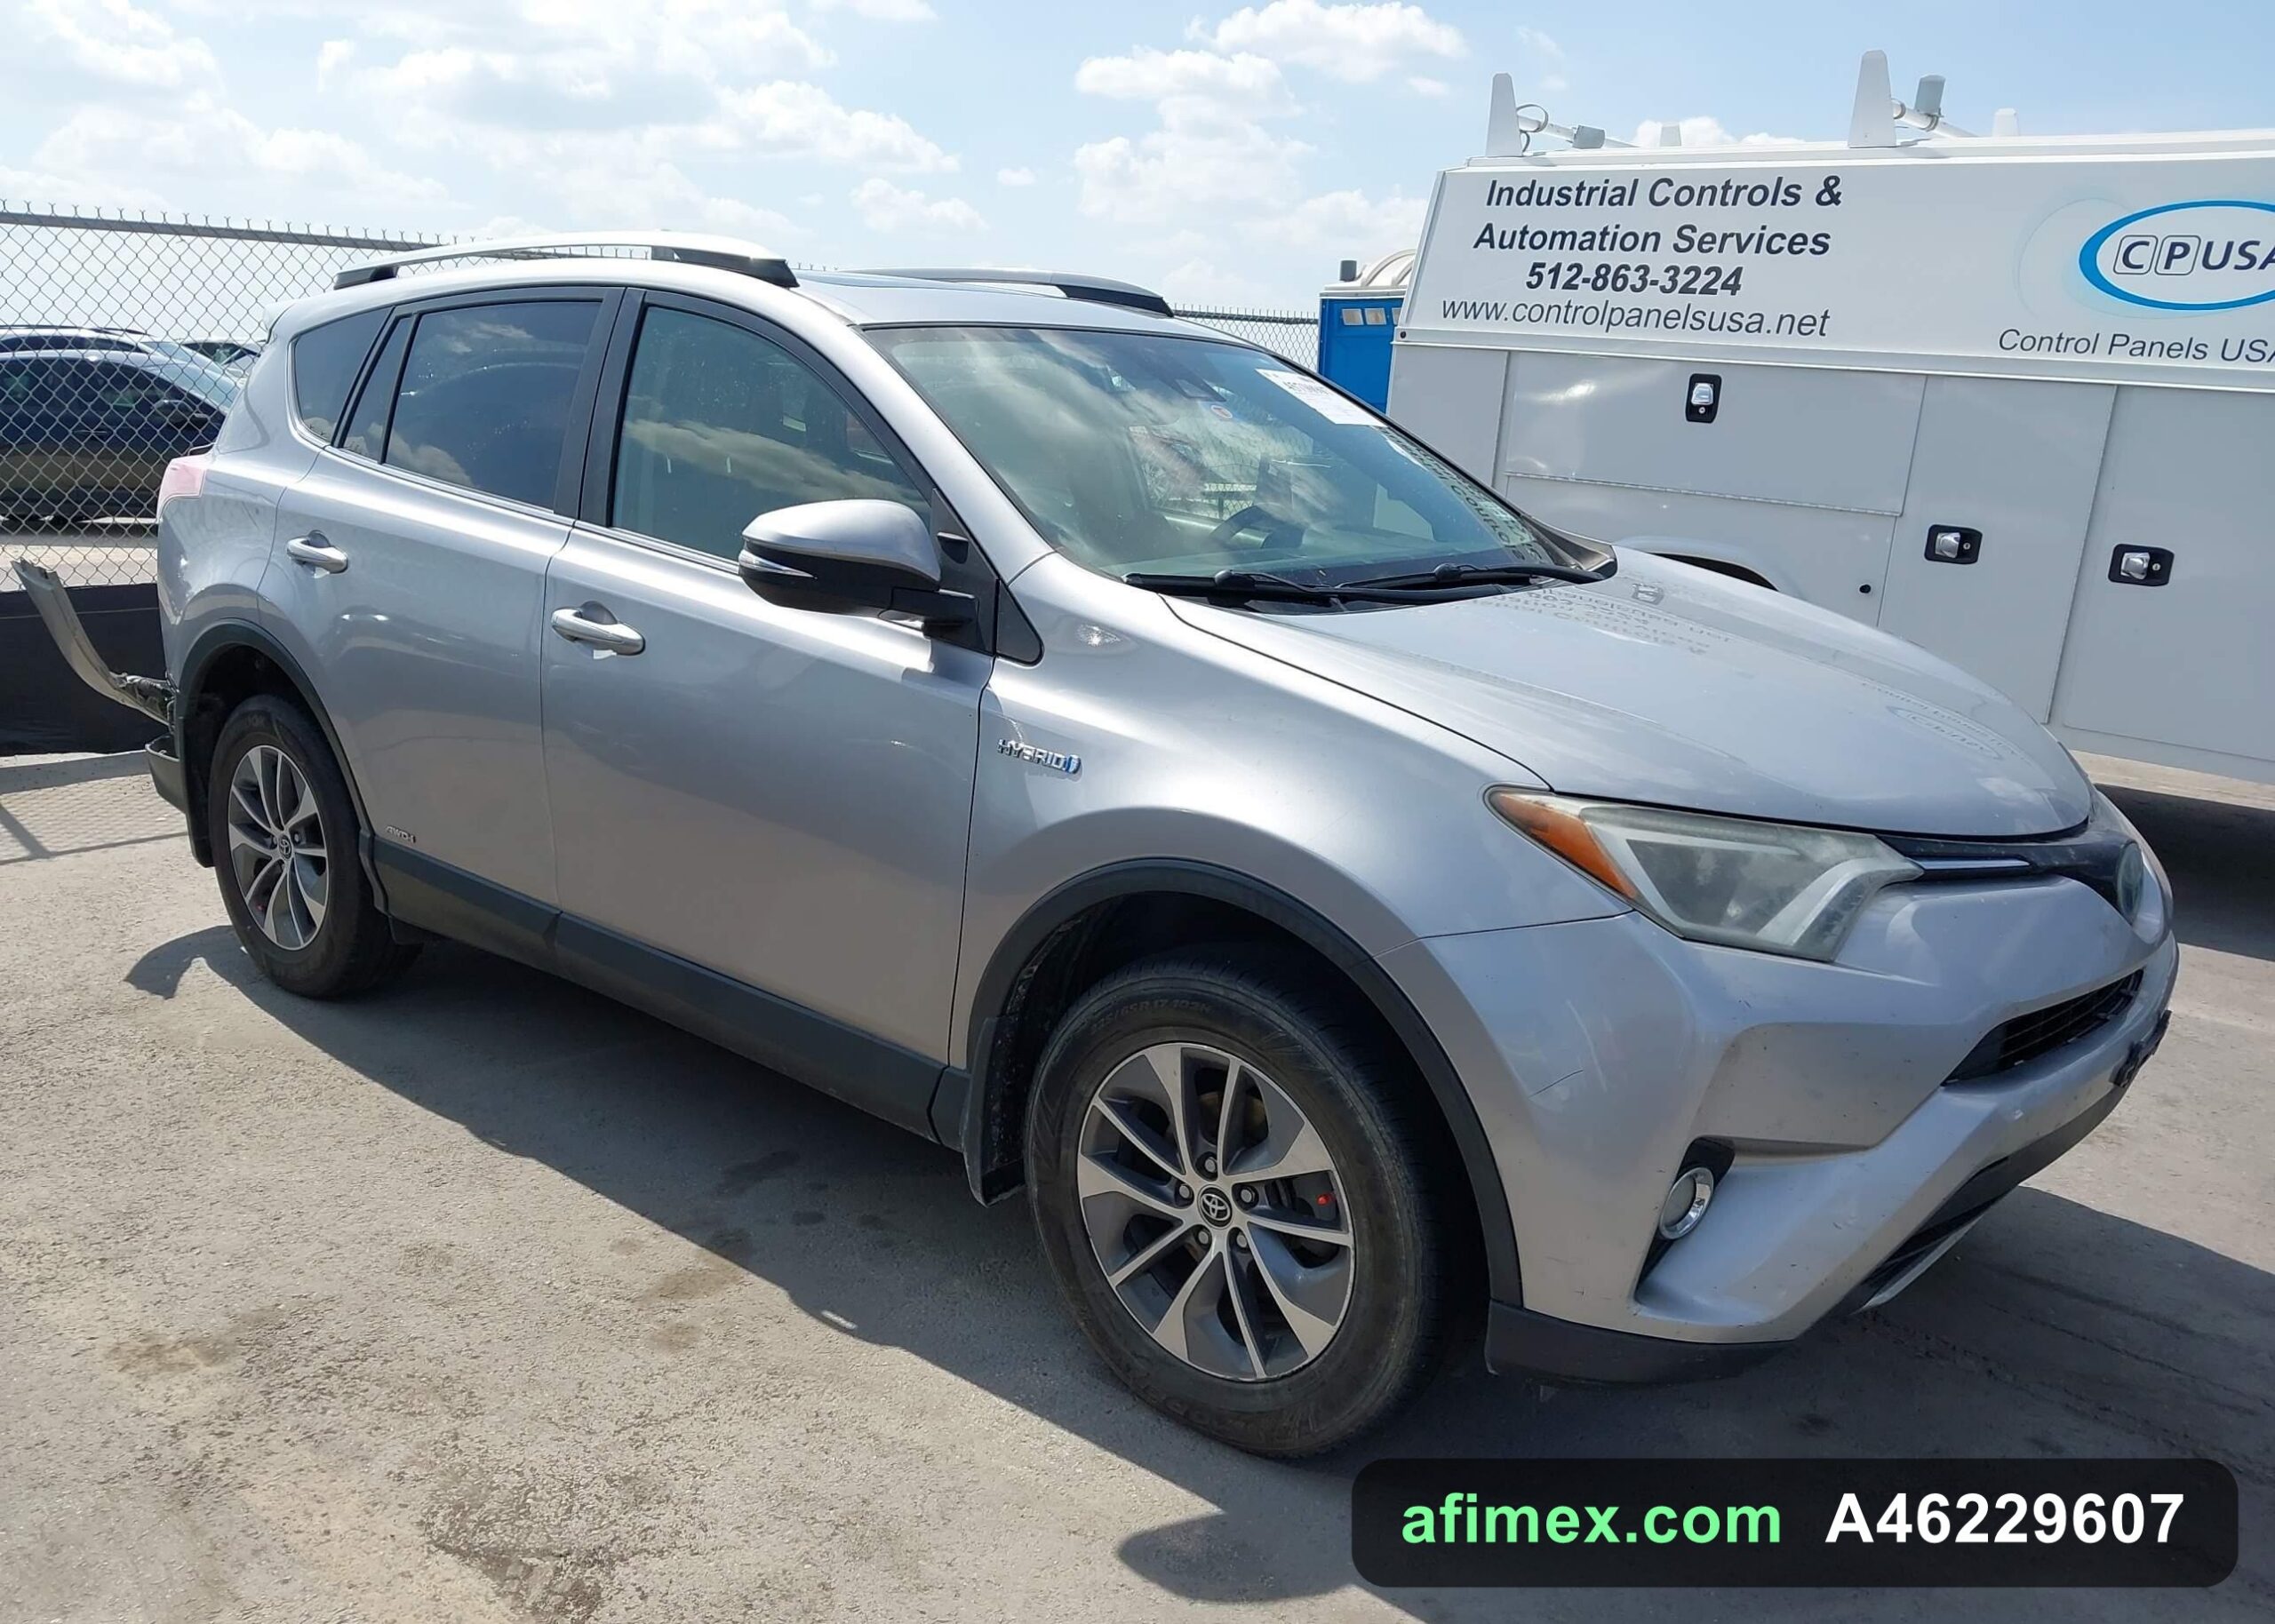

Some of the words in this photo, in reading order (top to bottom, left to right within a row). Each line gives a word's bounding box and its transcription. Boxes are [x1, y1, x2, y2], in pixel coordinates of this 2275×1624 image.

[1487, 179, 1639, 206] Industrial
[1649, 177, 1801, 206] Controls
[1816, 176, 1841, 206] &
[1473, 223, 1660, 251] Automation
[1673, 225, 1831, 255] Services
[1526, 262, 1743, 296] 512-863-3224
[1442, 298, 1830, 336] www.controlpanelsusa.net
[2000, 329, 2099, 354] Control
[2109, 334, 2208, 360] Panels
[997, 738, 1066, 771] HYBRID
